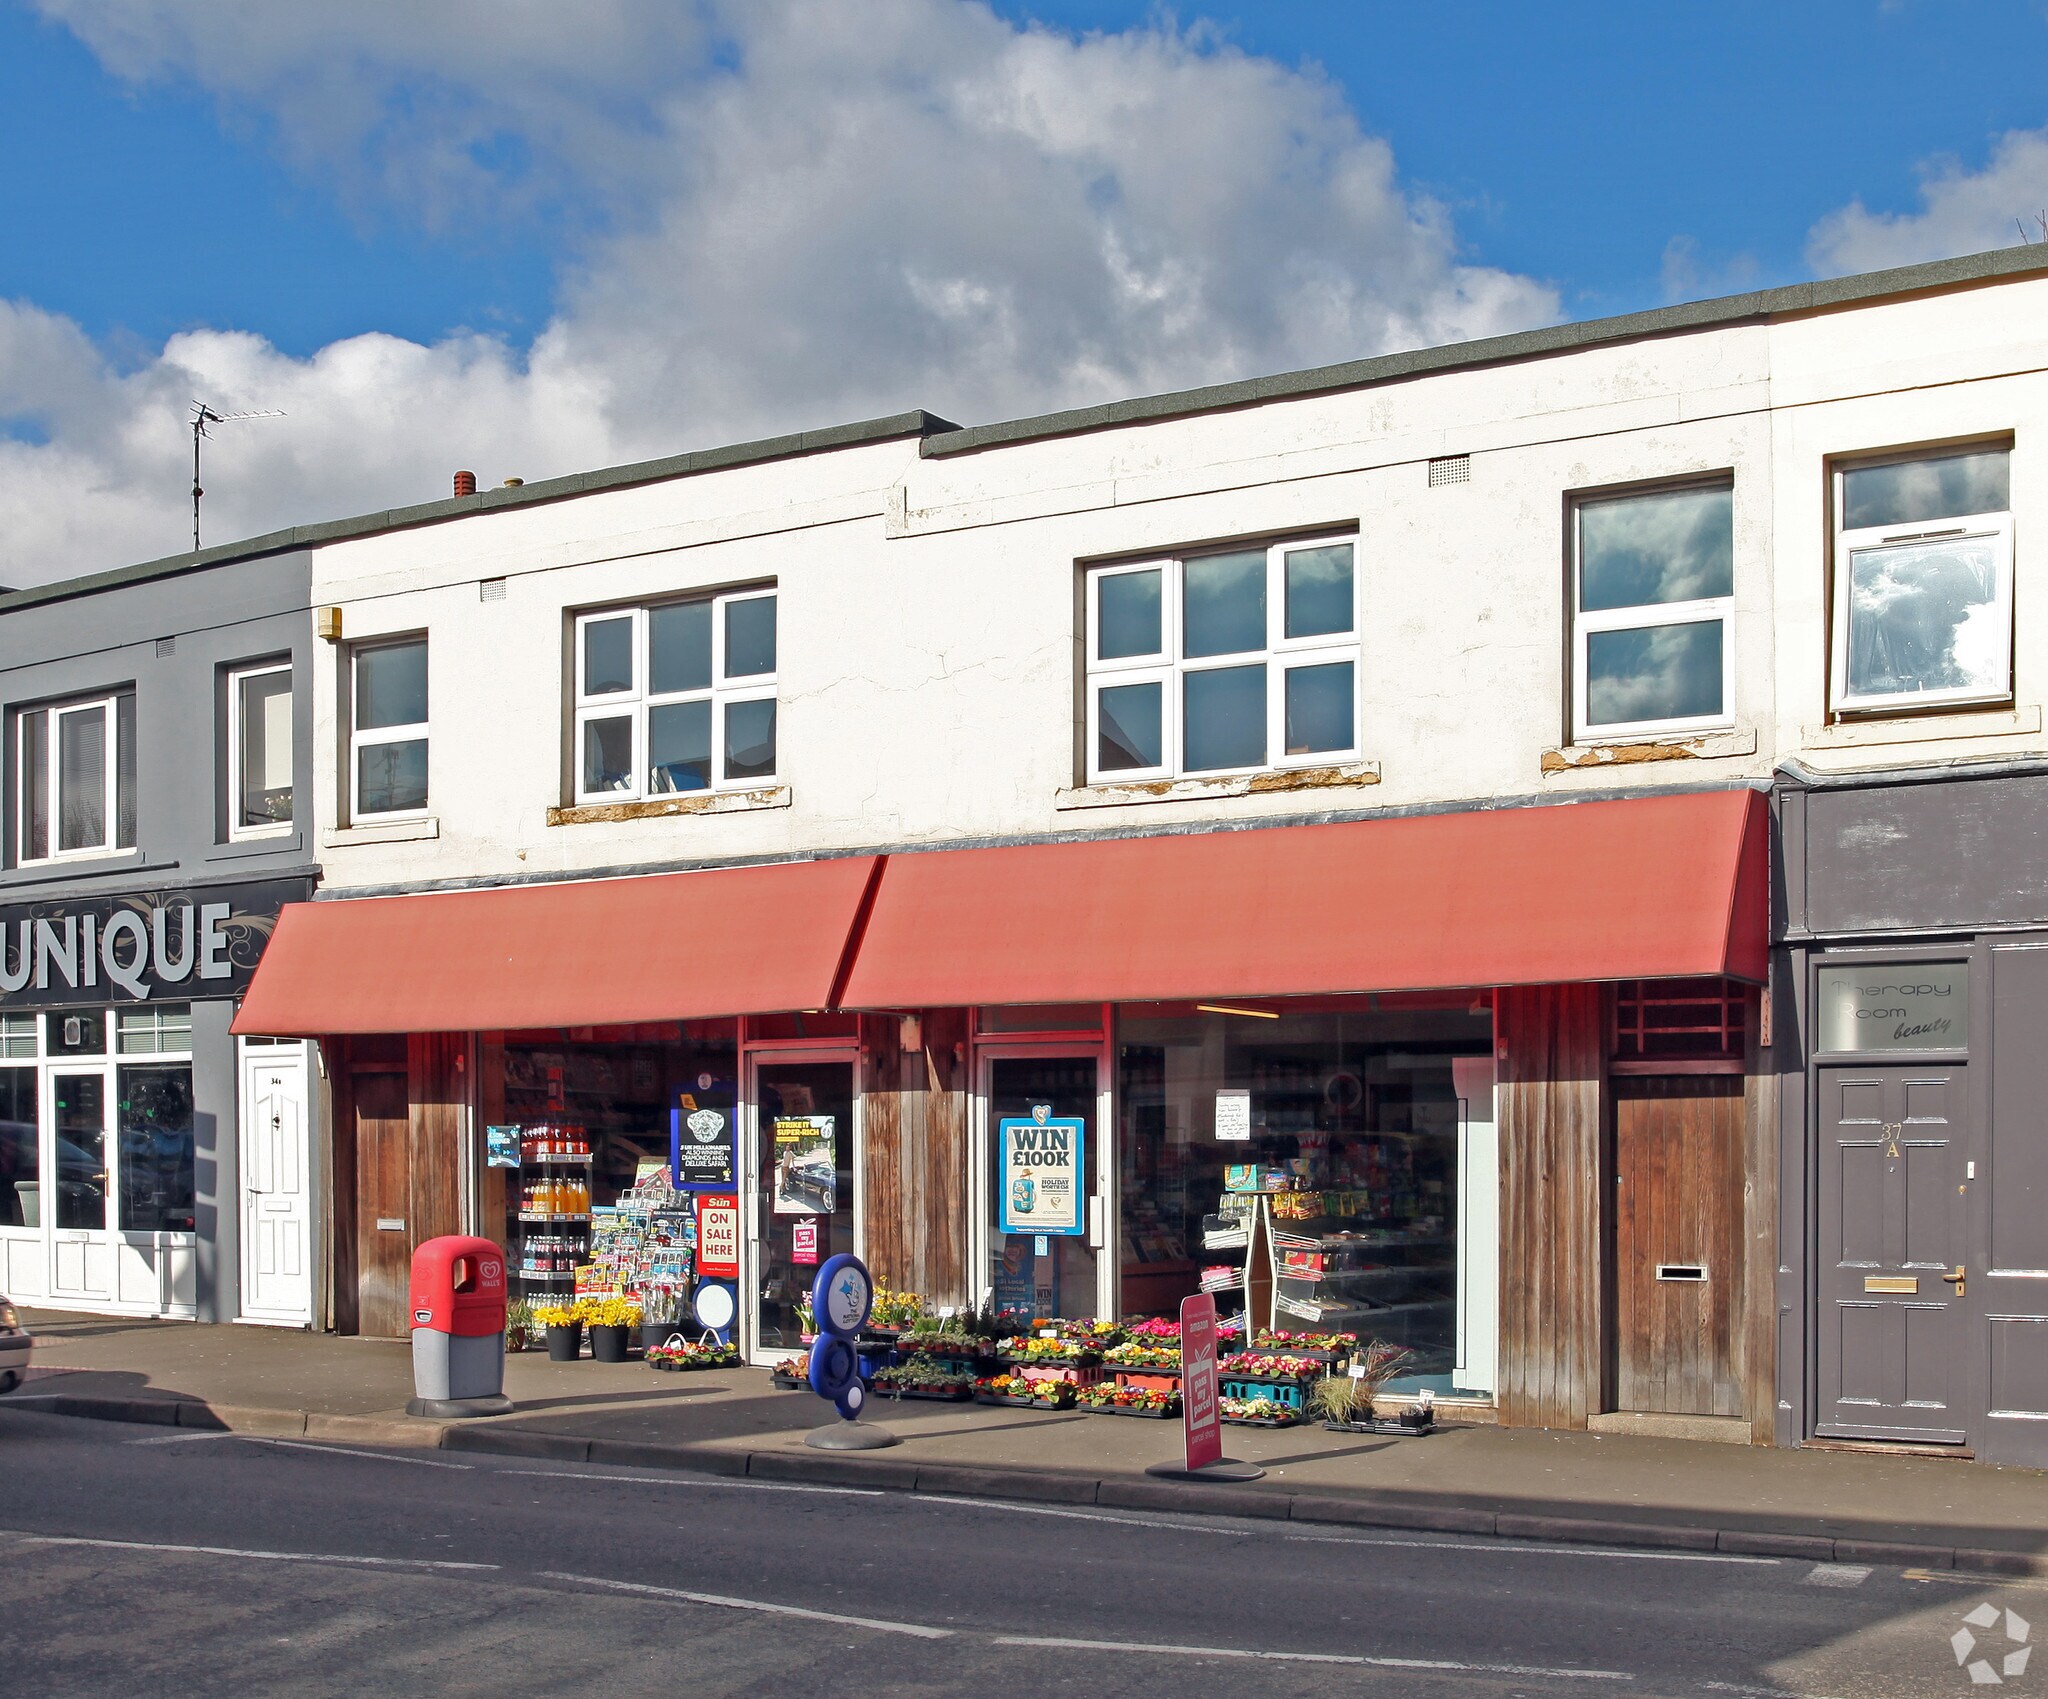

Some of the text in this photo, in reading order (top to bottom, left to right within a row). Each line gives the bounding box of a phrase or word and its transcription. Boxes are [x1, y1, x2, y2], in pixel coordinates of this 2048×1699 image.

[0, 903, 232, 1000] UNIQUE
[1831, 980, 1951, 996] Therapy
[1838, 1003, 1906, 1019] Room
[1894, 1018, 1951, 1040] beauty
[776, 1121, 810, 1129] STRIKE IT
[776, 1128, 820, 1136] SUPER-RICH
[1881, 1123, 1902, 1140] 37
[1012, 1129, 1069, 1150] WIN
[1886, 1141, 1900, 1158] A
[1012, 1151, 1070, 1166] £100K
[709, 1213, 729, 1224] ON
[706, 1228, 732, 1240] SALE
[705, 1244, 733, 1256] HERE
[1036, 1288, 1053, 1299] WIN
[1189, 1319, 1209, 1333] amazon
[1194, 1375, 1207, 1390] pass
[1197, 1388, 1207, 1401] my
[1193, 1395, 1212, 1418] parcel
[1191, 1428, 1216, 1445] parcel shop
